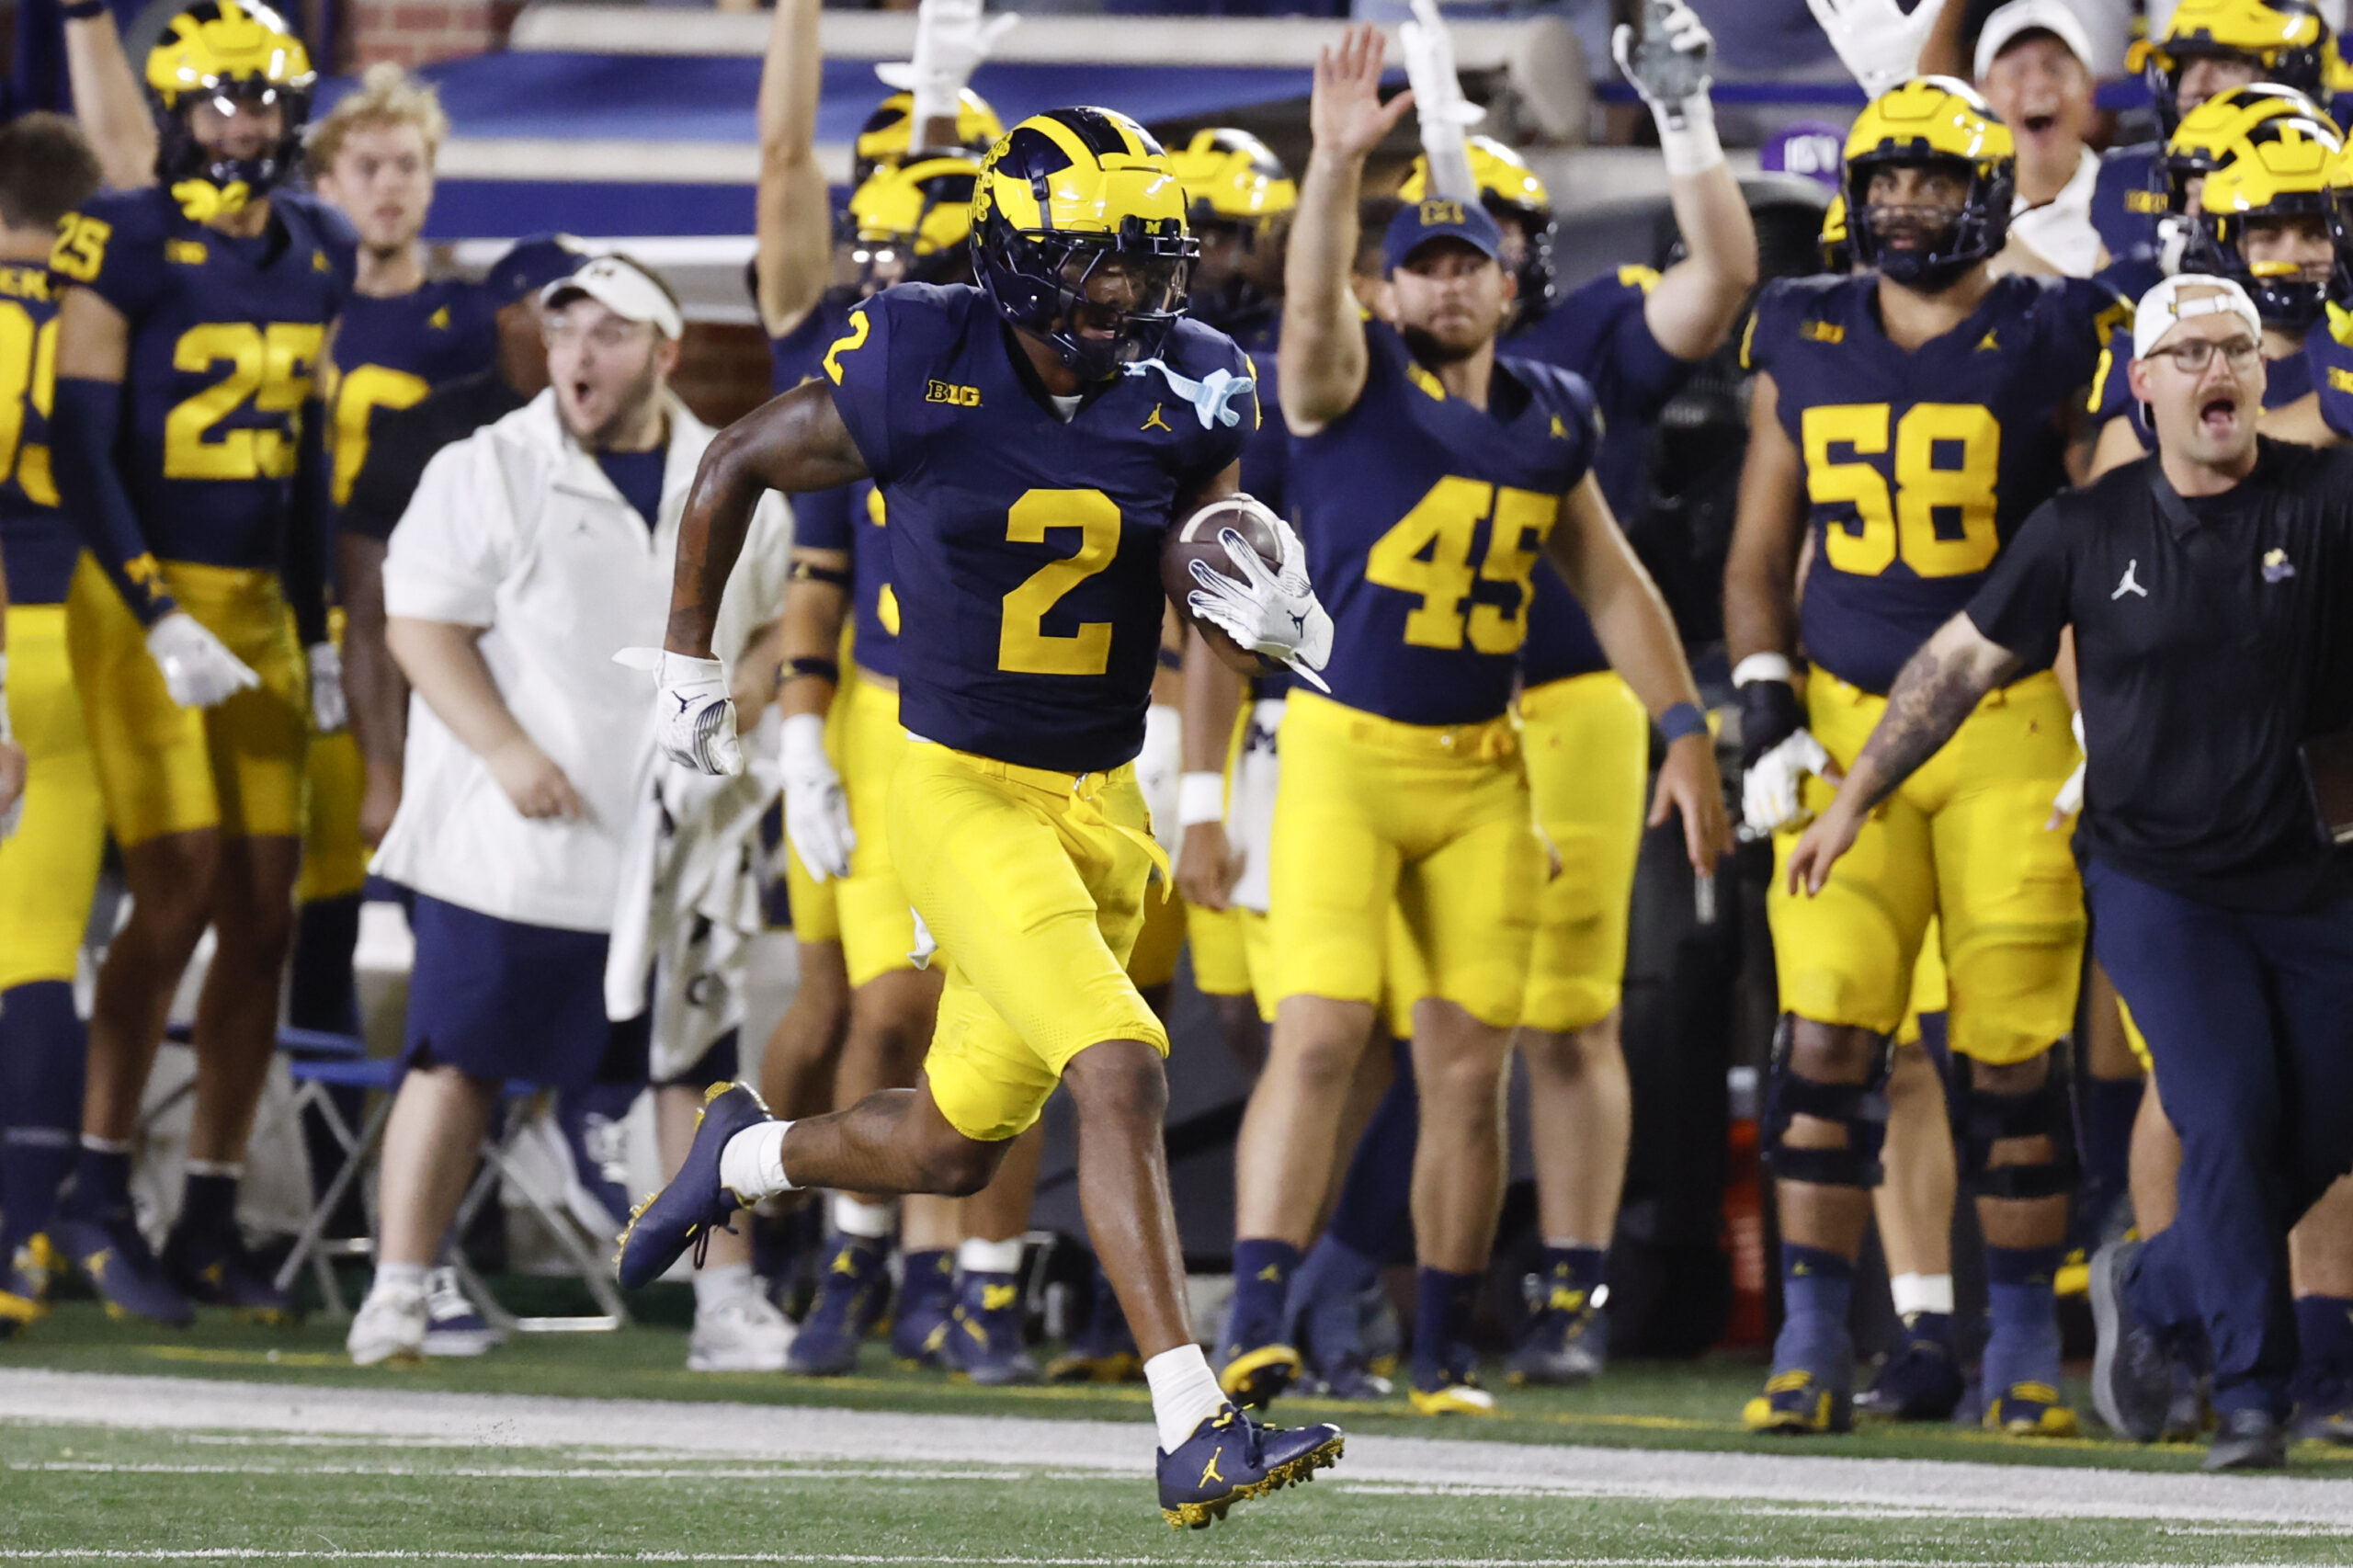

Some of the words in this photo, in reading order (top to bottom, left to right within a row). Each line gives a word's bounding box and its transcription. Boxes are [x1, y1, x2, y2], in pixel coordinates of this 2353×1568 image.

[48, 210, 113, 283] 25
[163, 322, 324, 480] 25
[822, 310, 871, 387] 2
[1364, 473, 1560, 655] 45
[1801, 401, 2002, 579] 58
[997, 488, 1121, 676] 2
